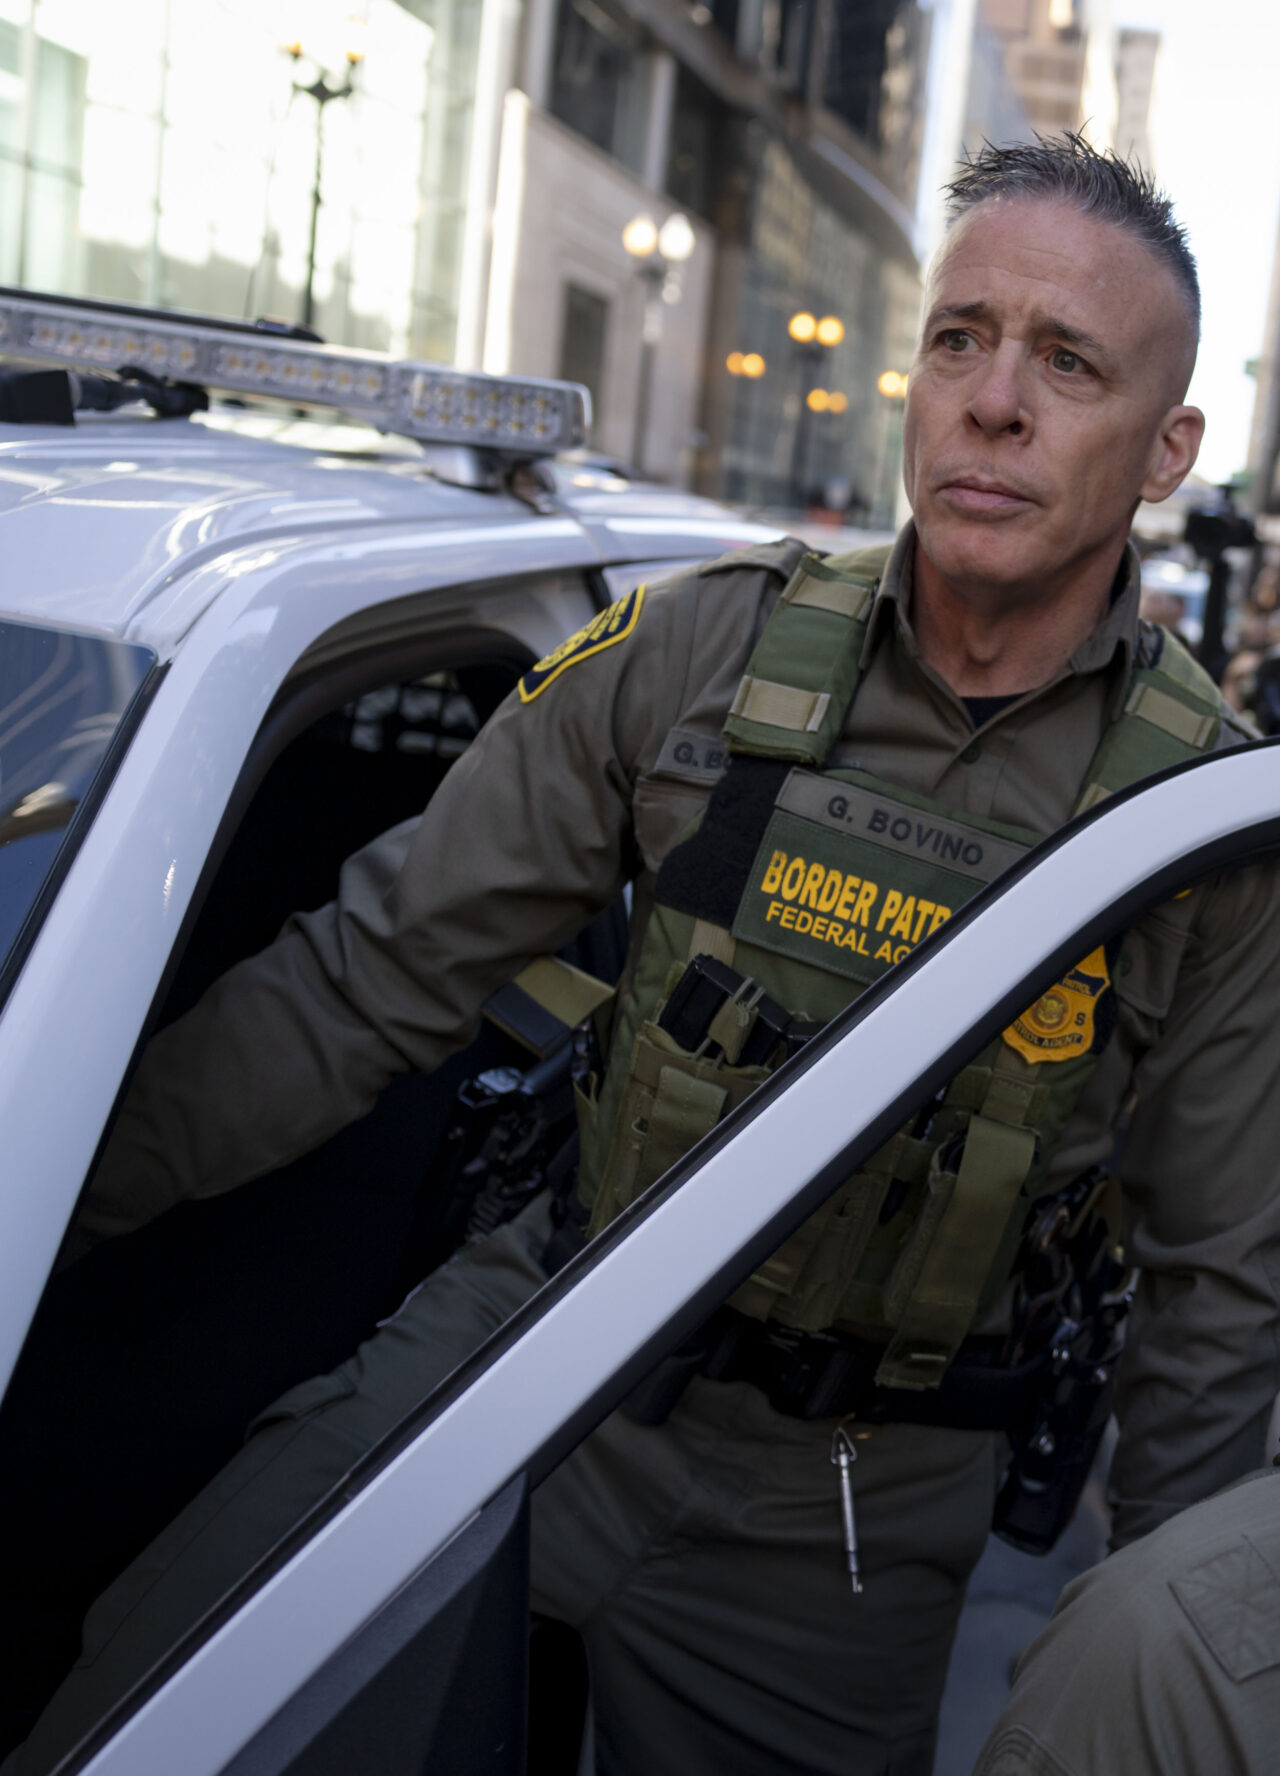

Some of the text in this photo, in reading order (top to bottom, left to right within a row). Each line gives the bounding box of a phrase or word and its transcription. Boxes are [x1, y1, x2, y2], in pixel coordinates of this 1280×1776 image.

[827, 795, 984, 867] G. BOVINO
[760, 849, 952, 944] BORDER PATR
[765, 900, 870, 956] FEDERAL
